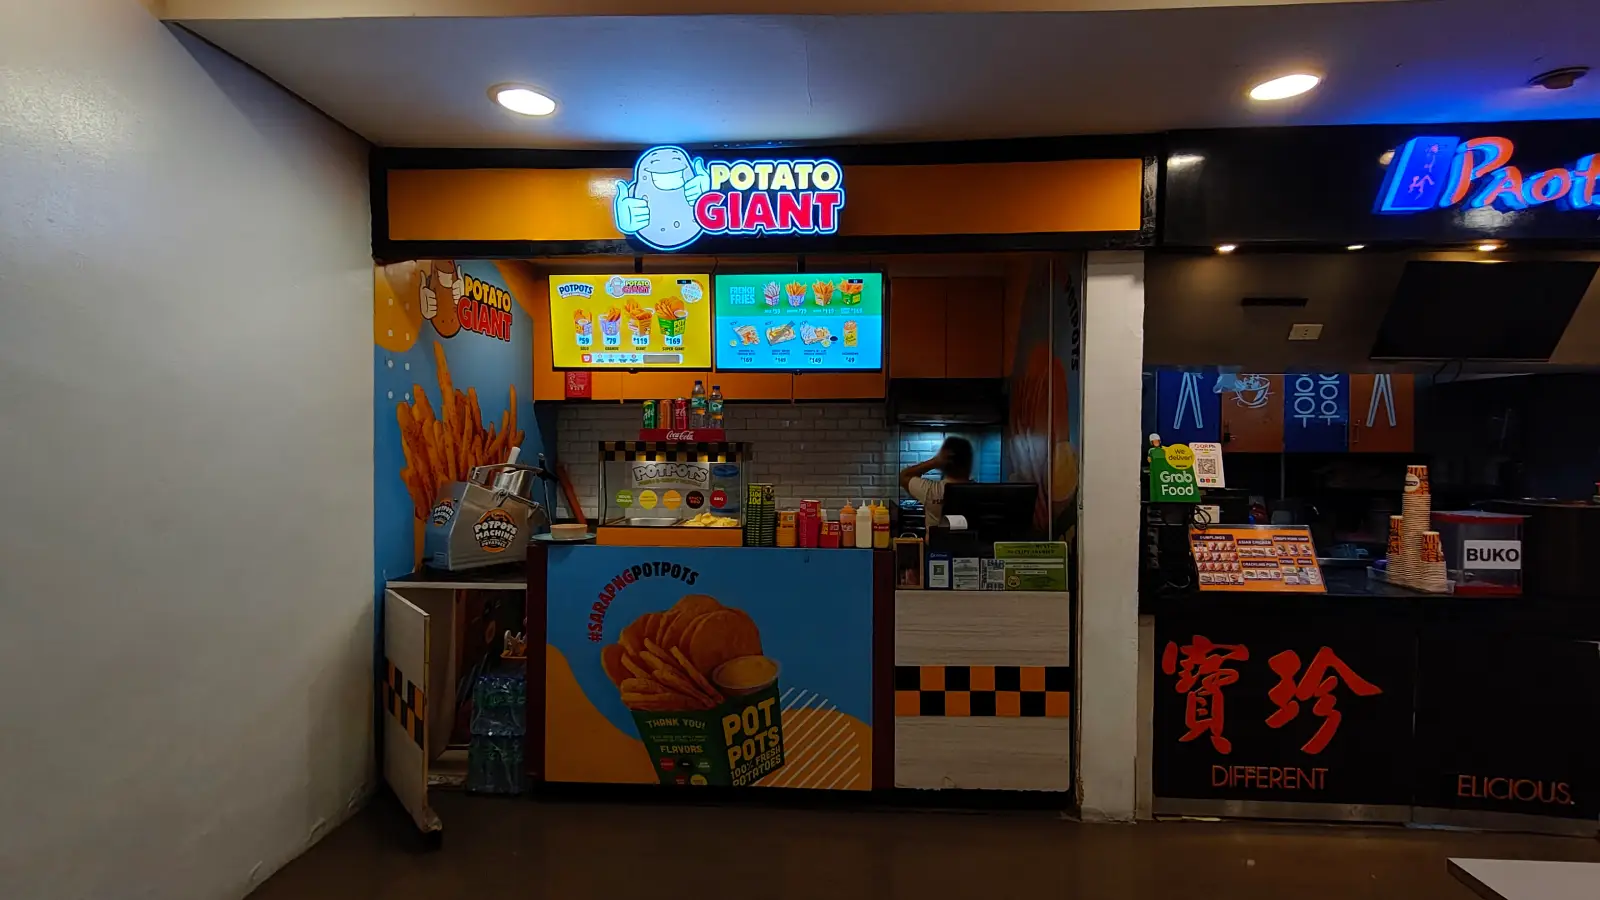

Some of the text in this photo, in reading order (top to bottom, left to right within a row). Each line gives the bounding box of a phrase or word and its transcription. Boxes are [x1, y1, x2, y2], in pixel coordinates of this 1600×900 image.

[710, 163, 839, 191] POTATO
[694, 191, 841, 231] GIANT
[463, 274, 512, 313] POTATO
[558, 284, 593, 295] POTPOTS
[729, 286, 755, 295] FRENCH
[730, 294, 756, 305] FRIES
[457, 296, 513, 341] GIANT
[633, 462, 709, 482] POTPOTS
[1159, 470, 1193, 483] Grab
[1161, 483, 1194, 496] Food
[474, 520, 518, 534] POTPOTS
[475, 529, 516, 542] MACHINE
[1466, 548, 1520, 562] BUKO
[588, 561, 700, 643] #SARAPNGPOTPOTS
[1161, 635, 1384, 754] 寶珍
[645, 717, 706, 730] THANK YOU!
[722, 697, 776, 747] POT
[659, 744, 705, 754] FLAVORS
[727, 726, 780, 770] POTS
[730, 745, 781, 780] 100% FRESH
[732, 754, 781, 787] POTATOES
[1211, 764, 1329, 790] DIFFERENT
[1456, 774, 1576, 806] ELICIOUS.
